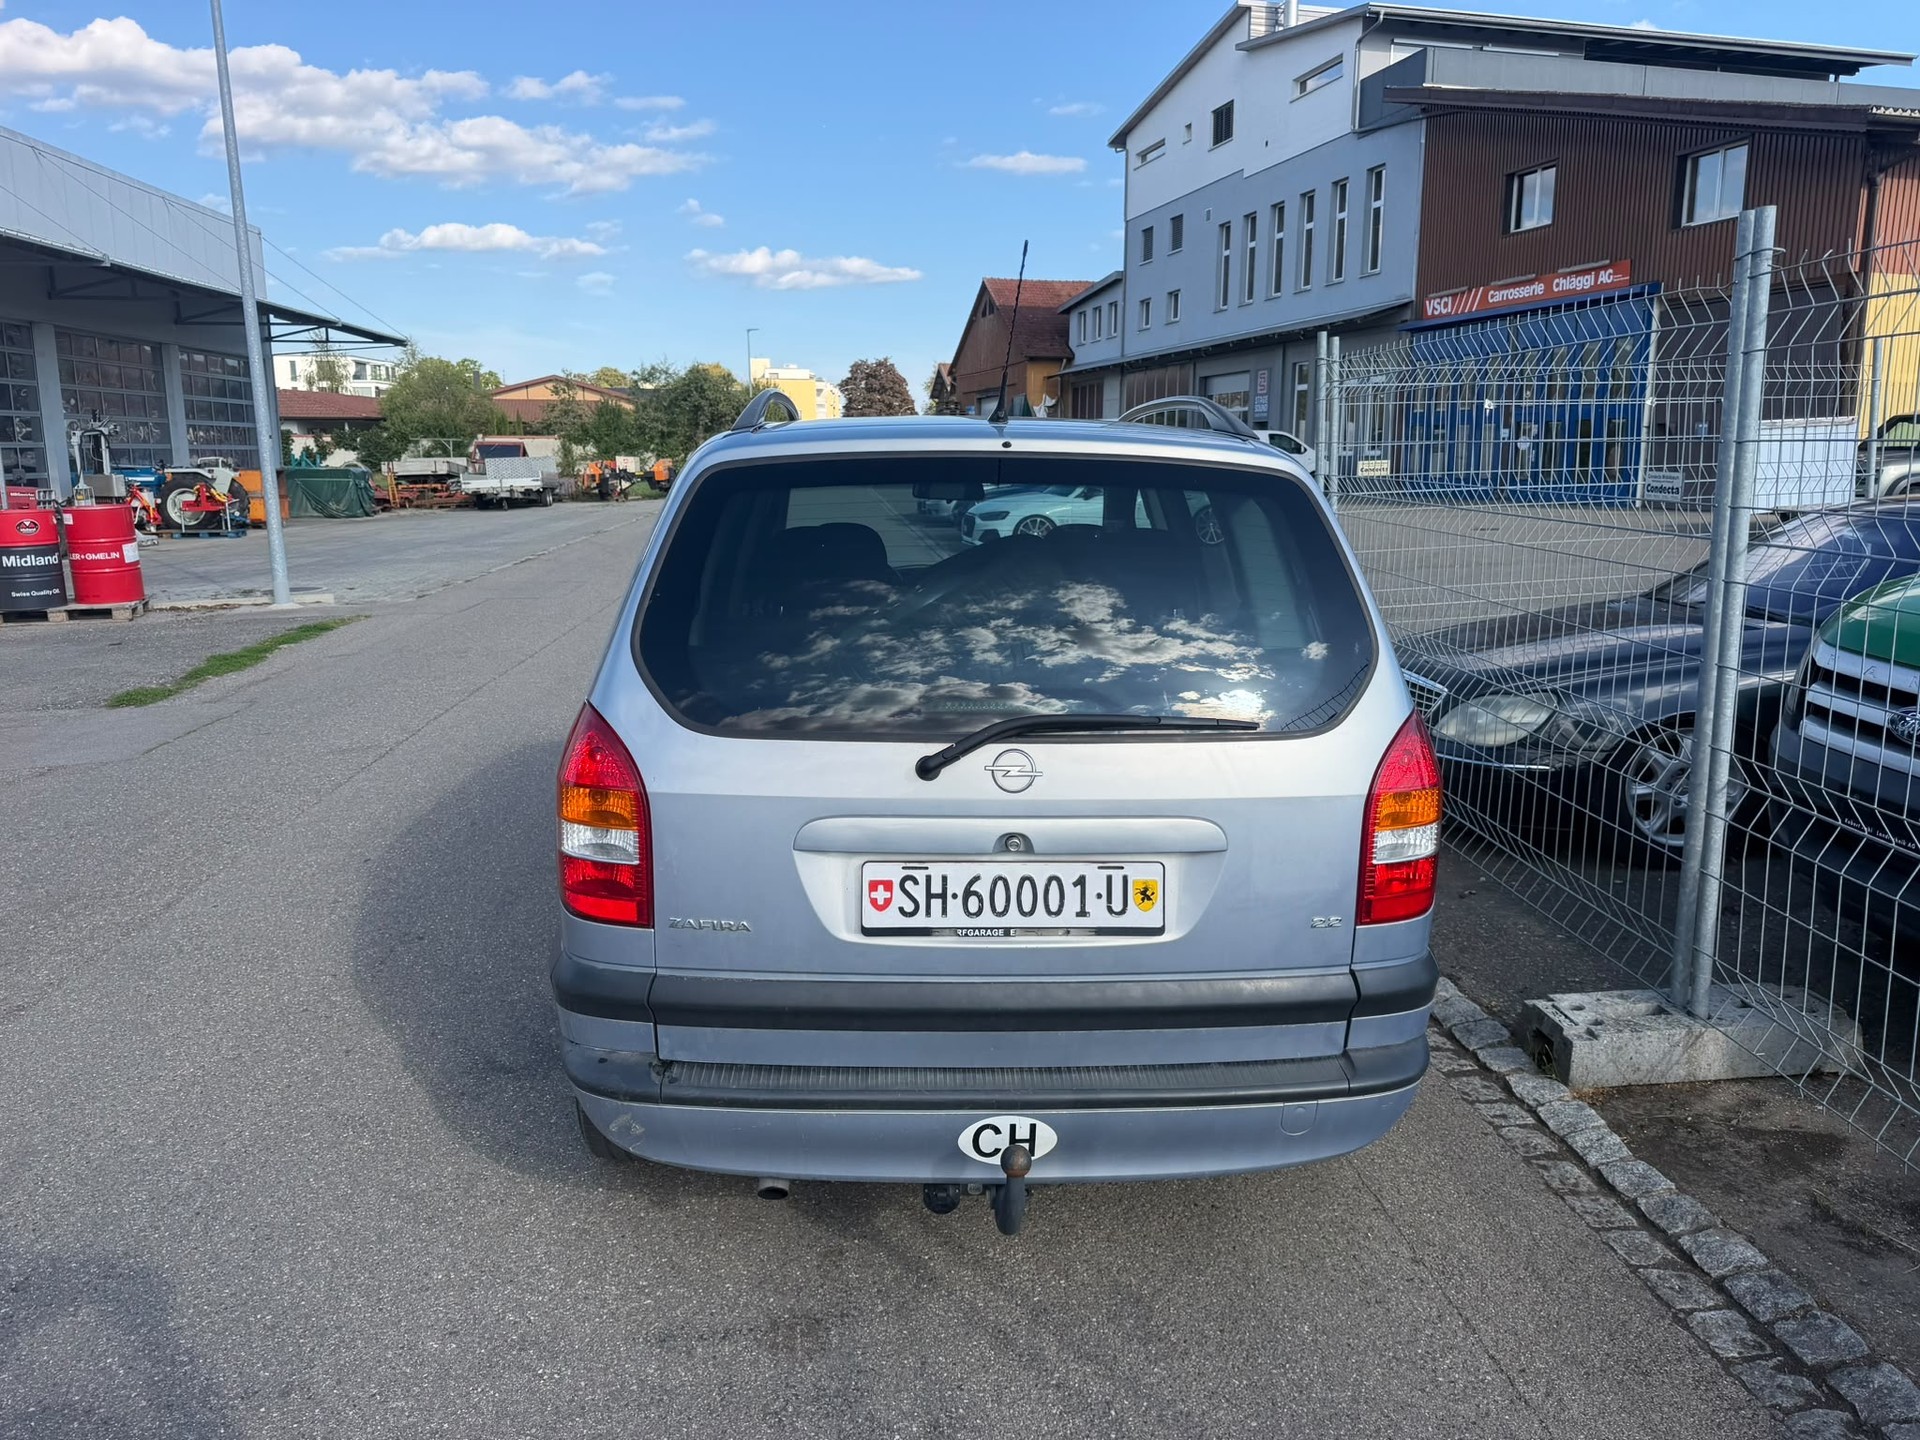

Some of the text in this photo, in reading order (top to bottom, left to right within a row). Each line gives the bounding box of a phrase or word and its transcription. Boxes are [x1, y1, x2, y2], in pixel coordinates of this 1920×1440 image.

[1425, 268, 1614, 316] VSCI Carrosserie Chläggi AG
[1646, 484, 1679, 494] Condecta
[2, 553, 59, 567] Midland
[668, 917, 752, 932] ZAFIRA
[972, 1123, 1037, 1158] CH
